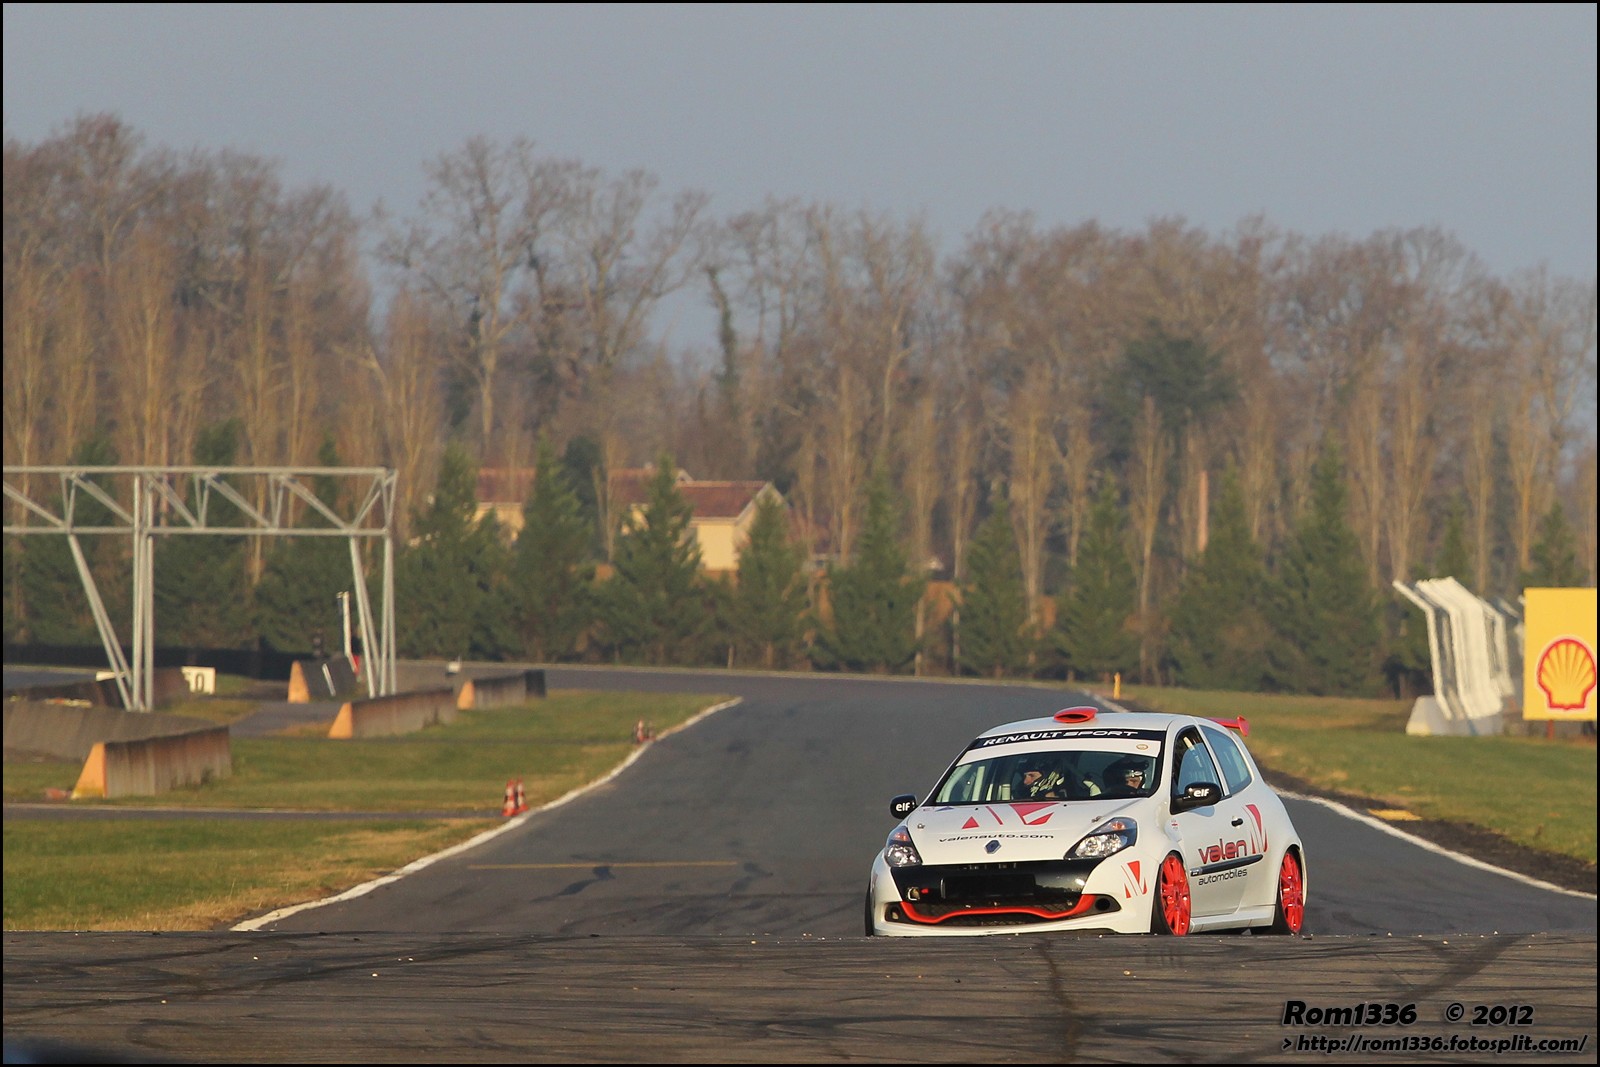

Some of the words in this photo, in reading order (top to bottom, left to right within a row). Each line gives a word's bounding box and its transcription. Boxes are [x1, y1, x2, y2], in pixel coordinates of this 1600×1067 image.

[983, 731, 1062, 746] RENAULT
[1193, 788, 1210, 797] elf
[895, 802, 911, 812] elf
[939, 834, 1054, 842] valenauto.com
[1198, 838, 1247, 864] valen
[1198, 868, 1247, 886] automobiles
